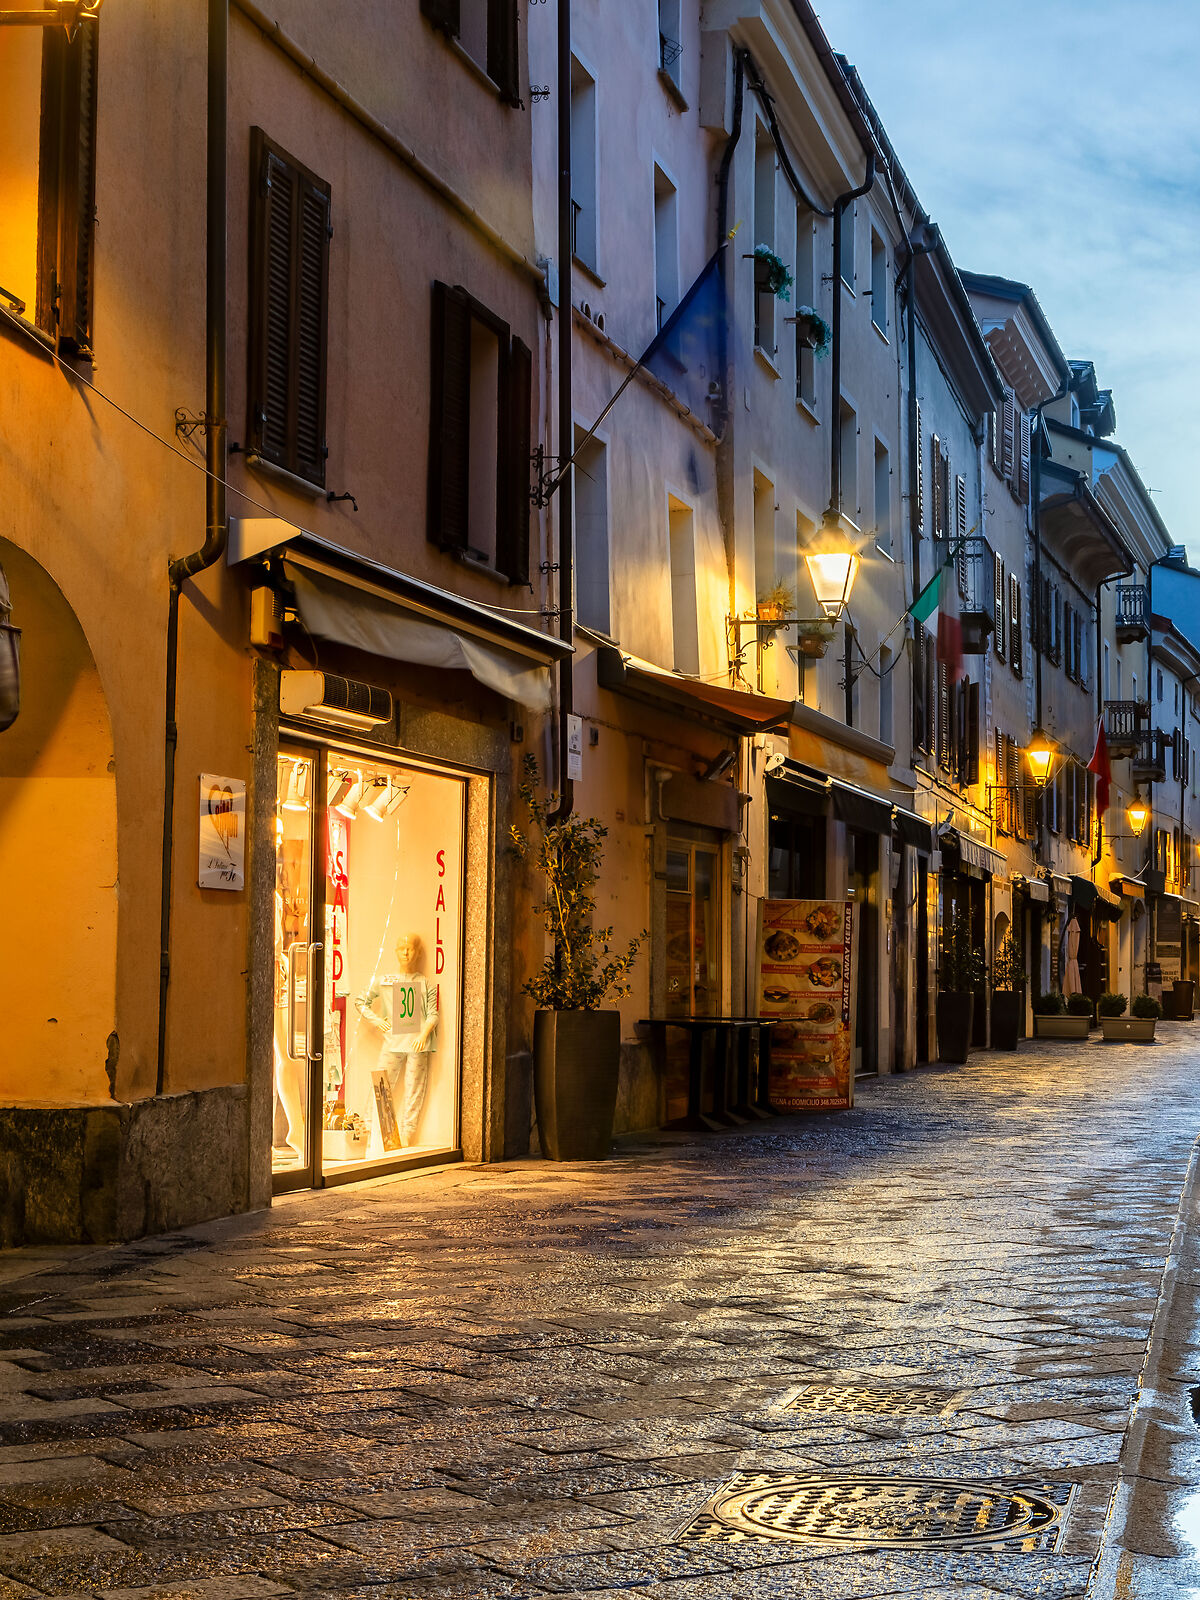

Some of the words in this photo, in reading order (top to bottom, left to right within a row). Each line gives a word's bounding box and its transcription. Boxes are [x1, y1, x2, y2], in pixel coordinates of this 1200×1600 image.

[332, 850, 345, 1013] SALDI
[435, 849, 446, 1012] SALDI
[399, 987, 415, 1019] 30
[842, 982, 850, 1010] TAKE
[791, 1098, 820, 1106] DOMICILIO
